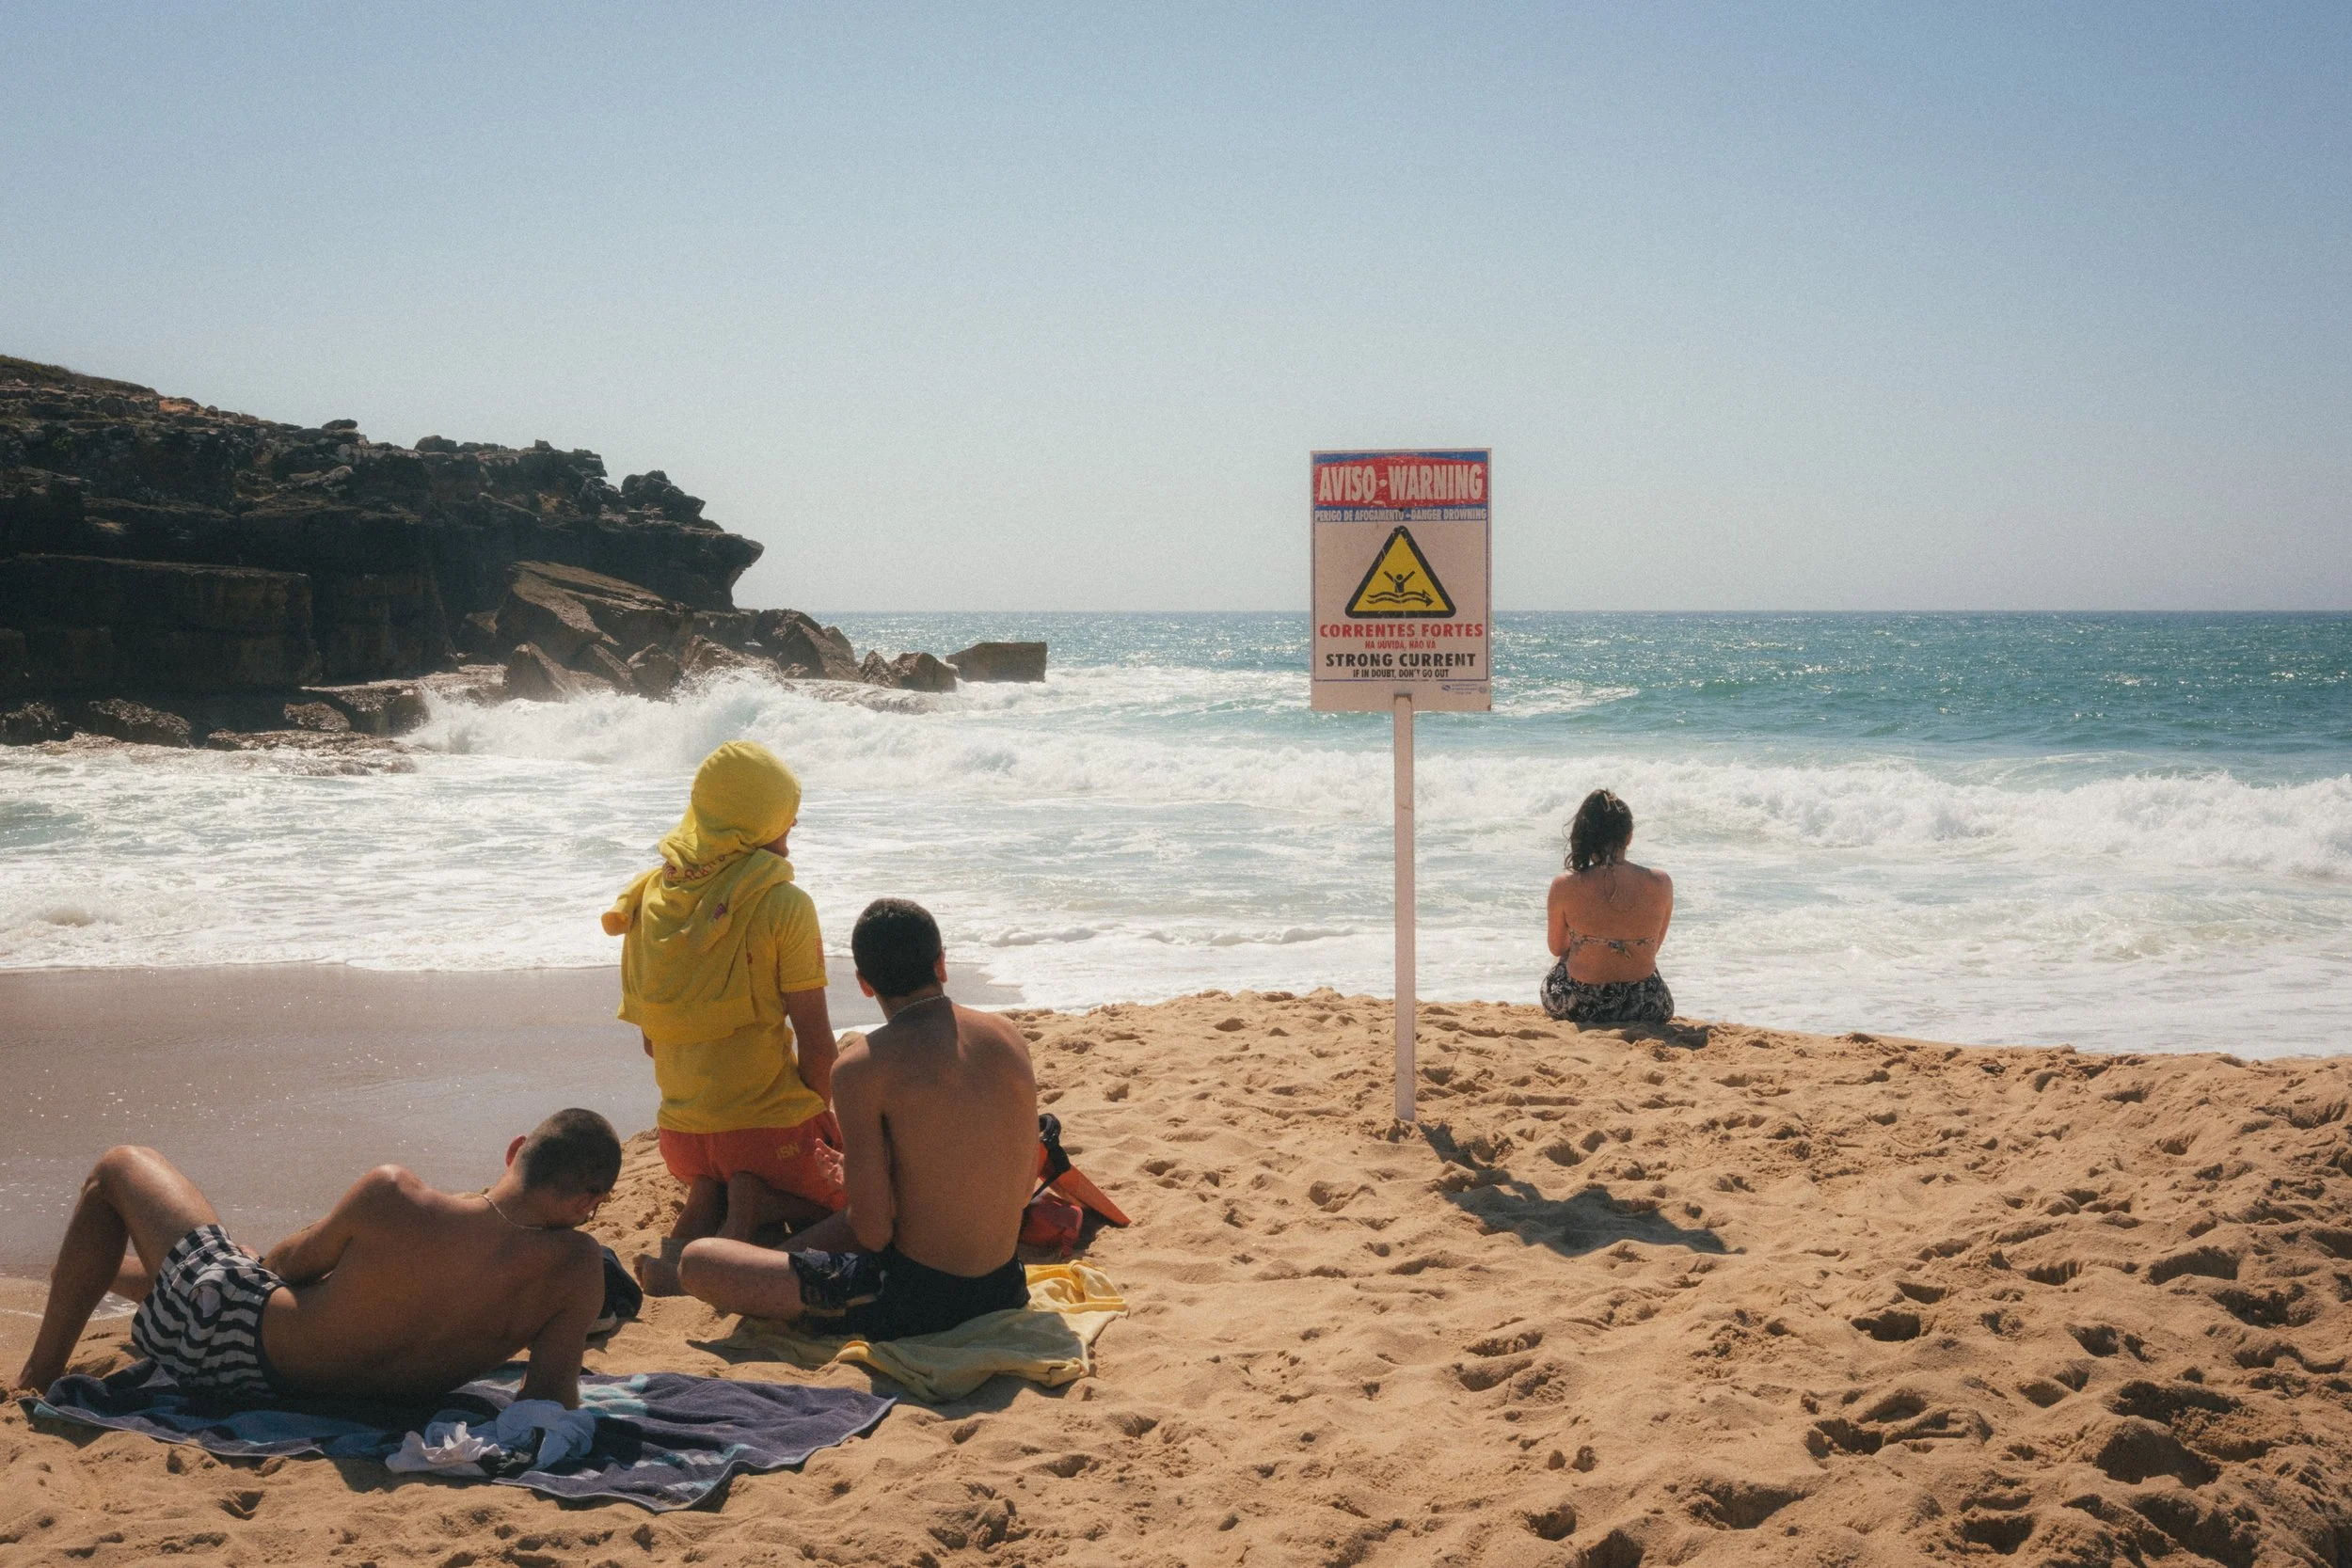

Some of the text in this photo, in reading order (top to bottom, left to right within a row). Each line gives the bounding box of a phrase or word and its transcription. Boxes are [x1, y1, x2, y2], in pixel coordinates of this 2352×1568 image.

[1318, 465, 1484, 501] AVISO WARNING
[1314, 510, 1342, 521] PERIGO
[1343, 510, 1354, 521] DE
[1411, 509, 1442, 520] DANGER
[1444, 508, 1486, 520] DROWNING
[1319, 624, 1484, 638] CORRENTES FORTES
[1326, 654, 1475, 667] STRONG CURRENT
[1353, 669, 1449, 679] IF IN DOUBT, DON'T GO OUT
